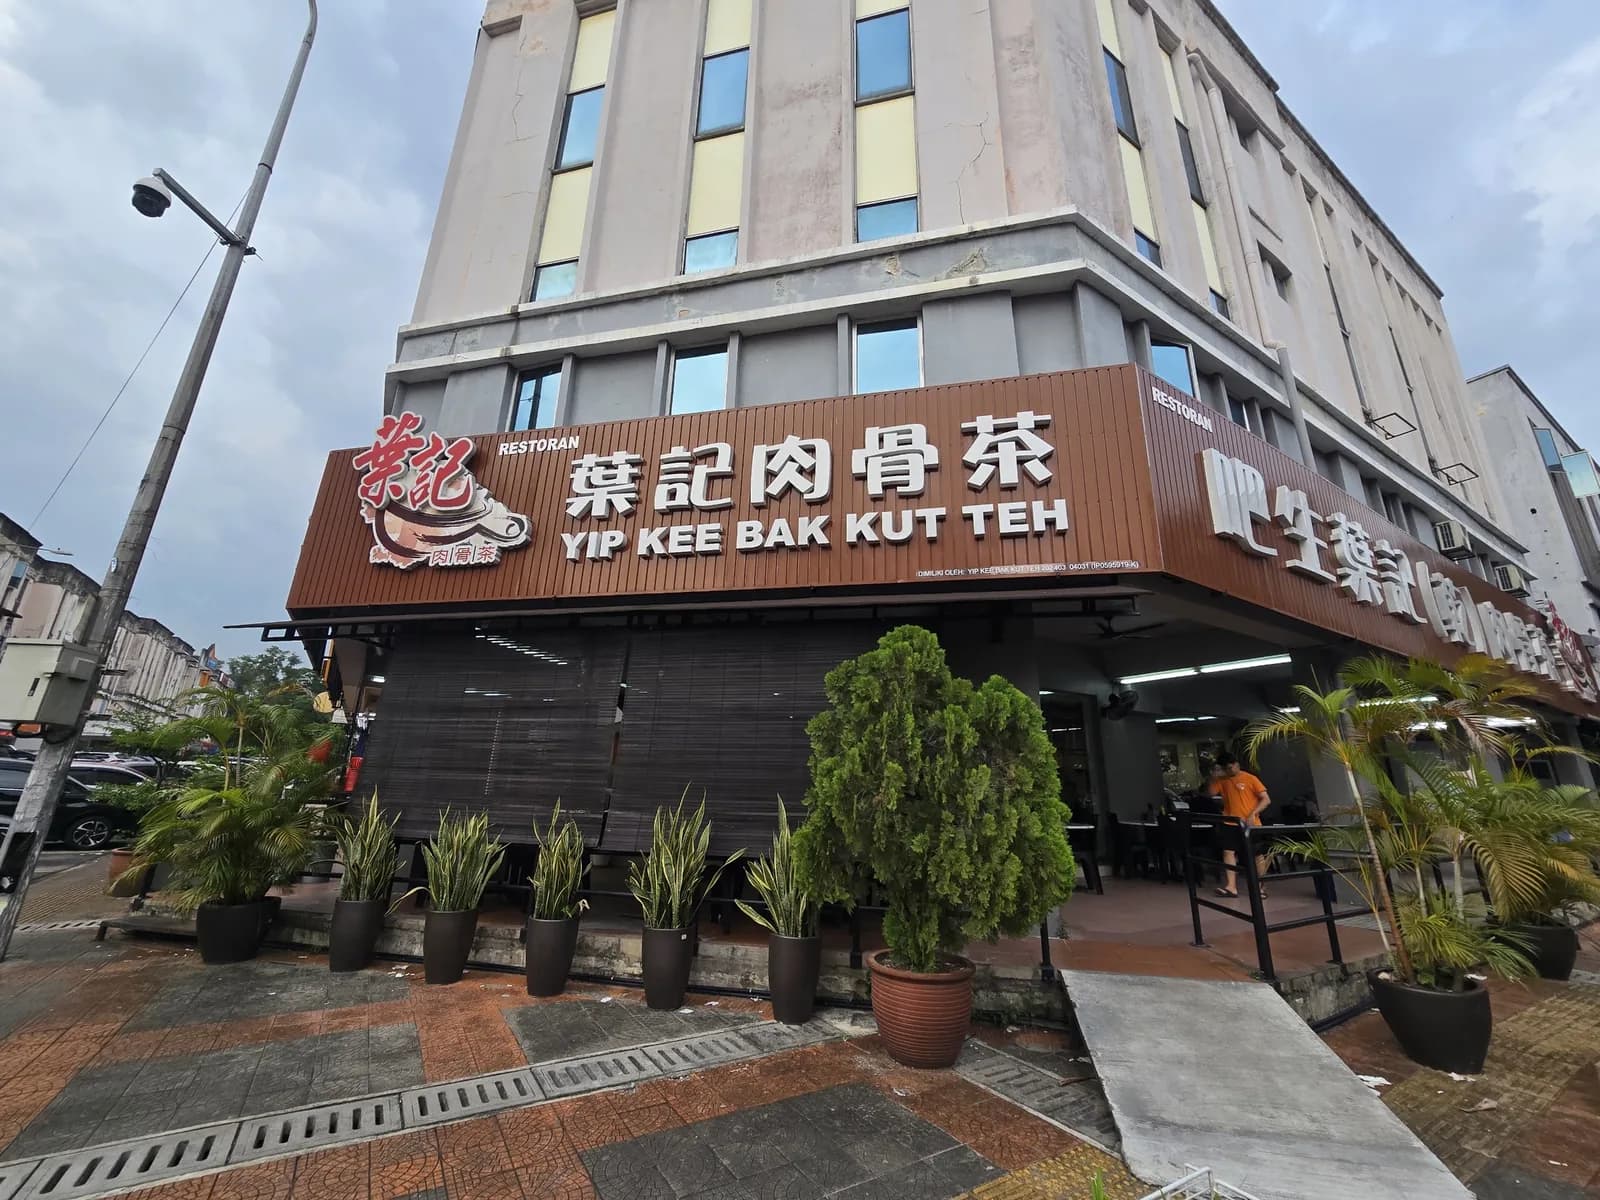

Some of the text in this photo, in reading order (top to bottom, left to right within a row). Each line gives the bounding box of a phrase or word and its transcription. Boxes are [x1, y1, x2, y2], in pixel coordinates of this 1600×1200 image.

[1152, 386, 1213, 433] RESTORAN
[499, 436, 580, 456] RESTORAN
[566, 411, 1055, 519] 葉記肉骨茶
[561, 499, 1069, 561] YIP KEE BAK KUT TEH
